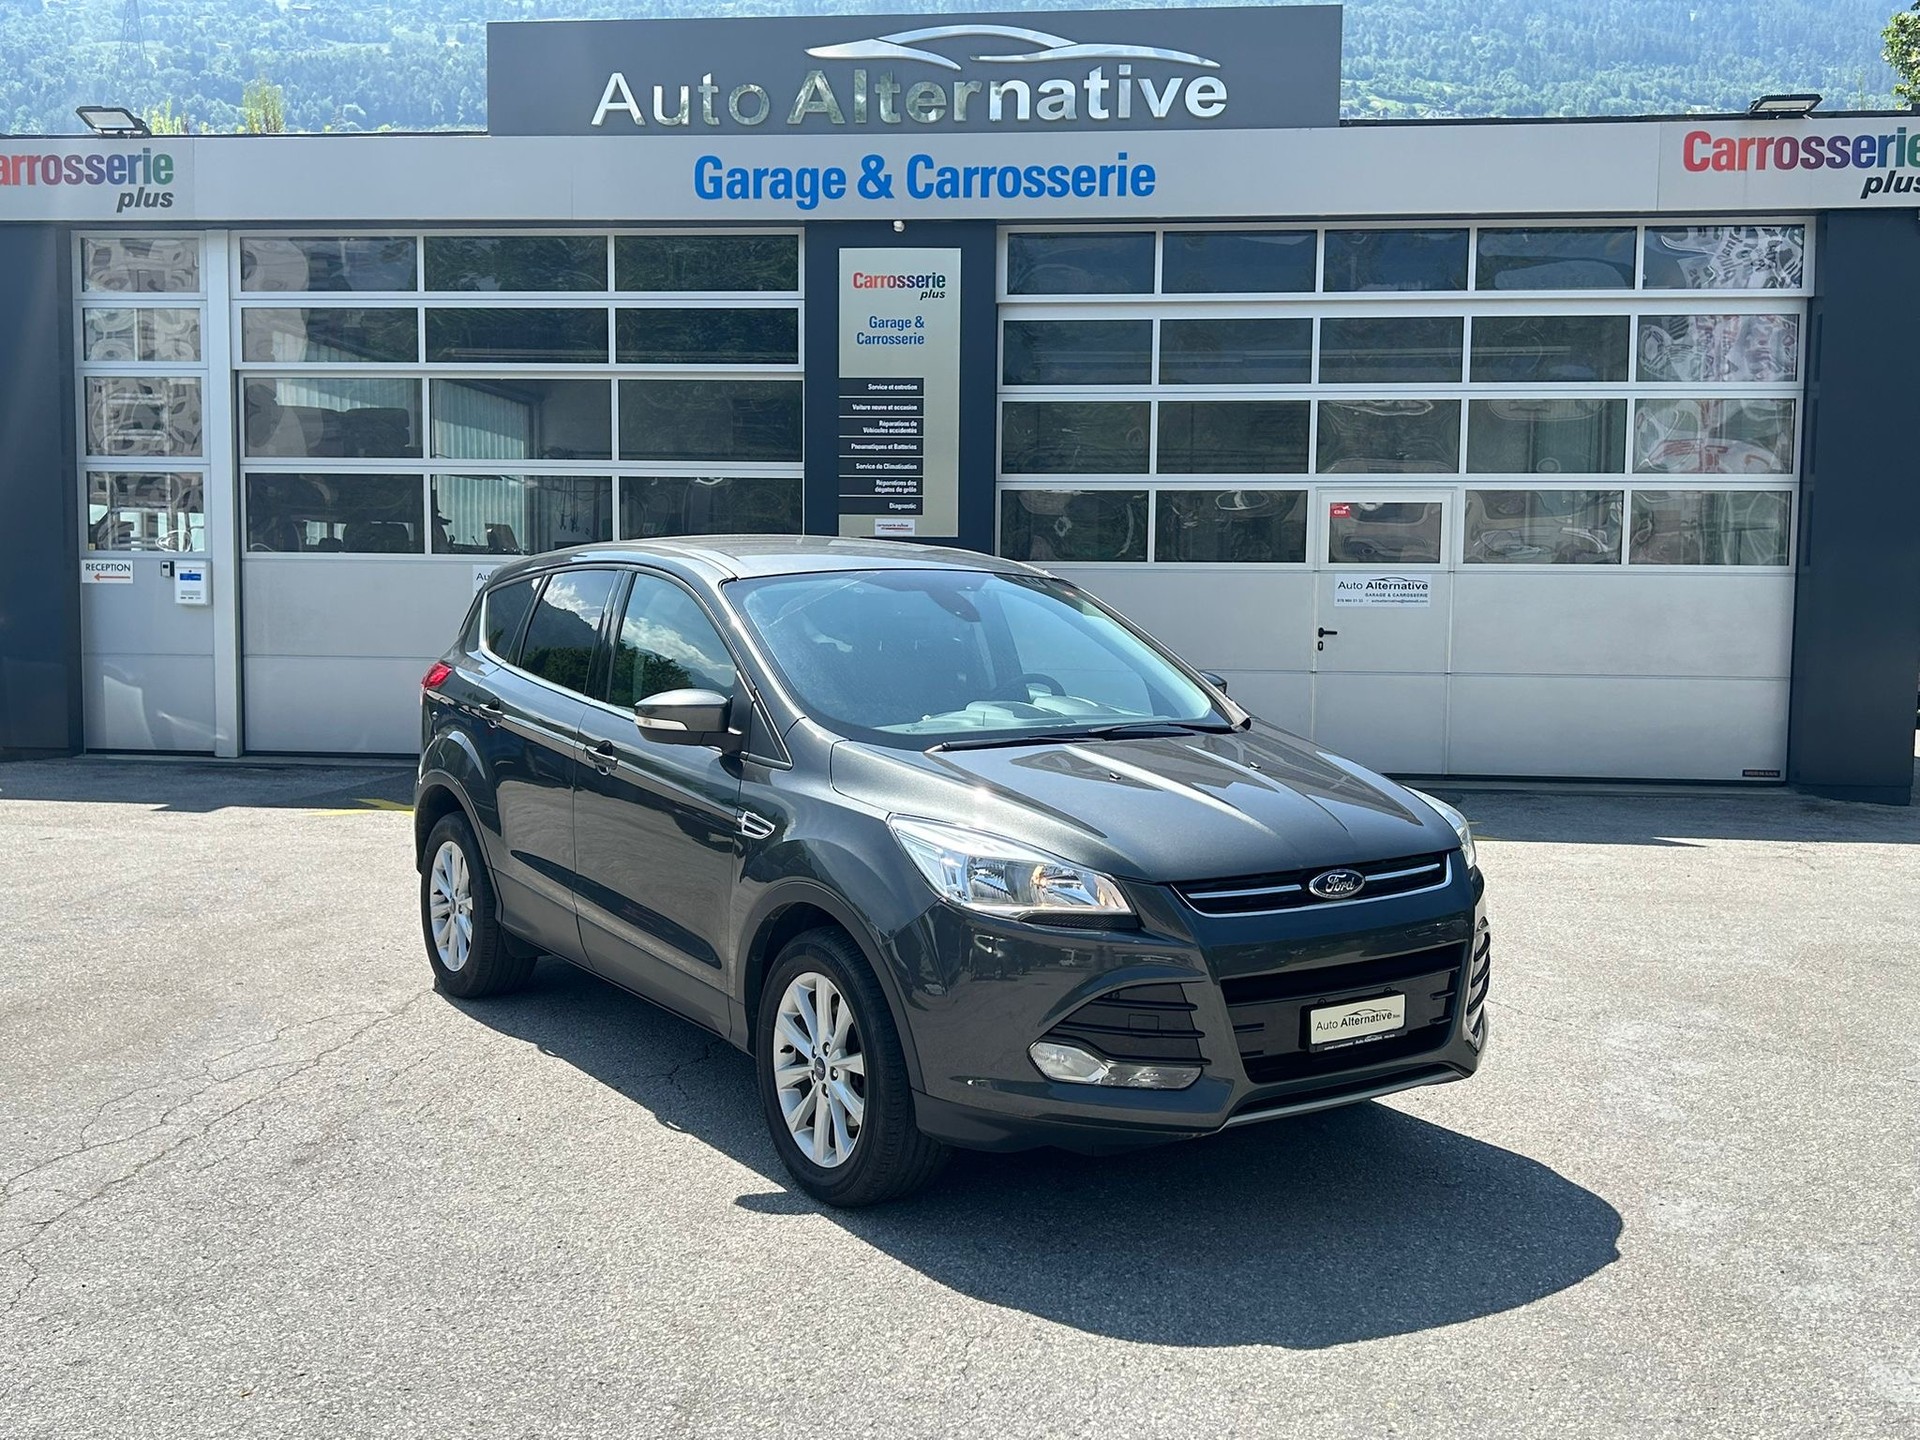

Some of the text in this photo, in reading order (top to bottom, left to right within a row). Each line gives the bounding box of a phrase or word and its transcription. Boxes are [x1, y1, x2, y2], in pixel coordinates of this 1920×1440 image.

[591, 64, 1228, 126] Auto Alternative
[0, 147, 174, 186] arrosserie
[694, 152, 1156, 211] Garage & Carrosserie
[1860, 170, 1920, 200] plu
[116, 186, 174, 213] plus
[852, 272, 946, 289] Carrosserie
[919, 289, 946, 301] plus
[869, 315, 925, 331] Garage &
[856, 331, 925, 345] Carrosserie
[867, 383, 887, 391] Service
[852, 403, 871, 411] Voiture
[851, 443, 887, 451] Pneumatiques
[889, 502, 917, 510] Diagnostic
[85, 563, 131, 572] RECEPTION
[1337, 581, 1429, 591] Auto Alternative
[1325, 873, 1355, 893] Ford
[1315, 1011, 1393, 1031] Auto Alternative
